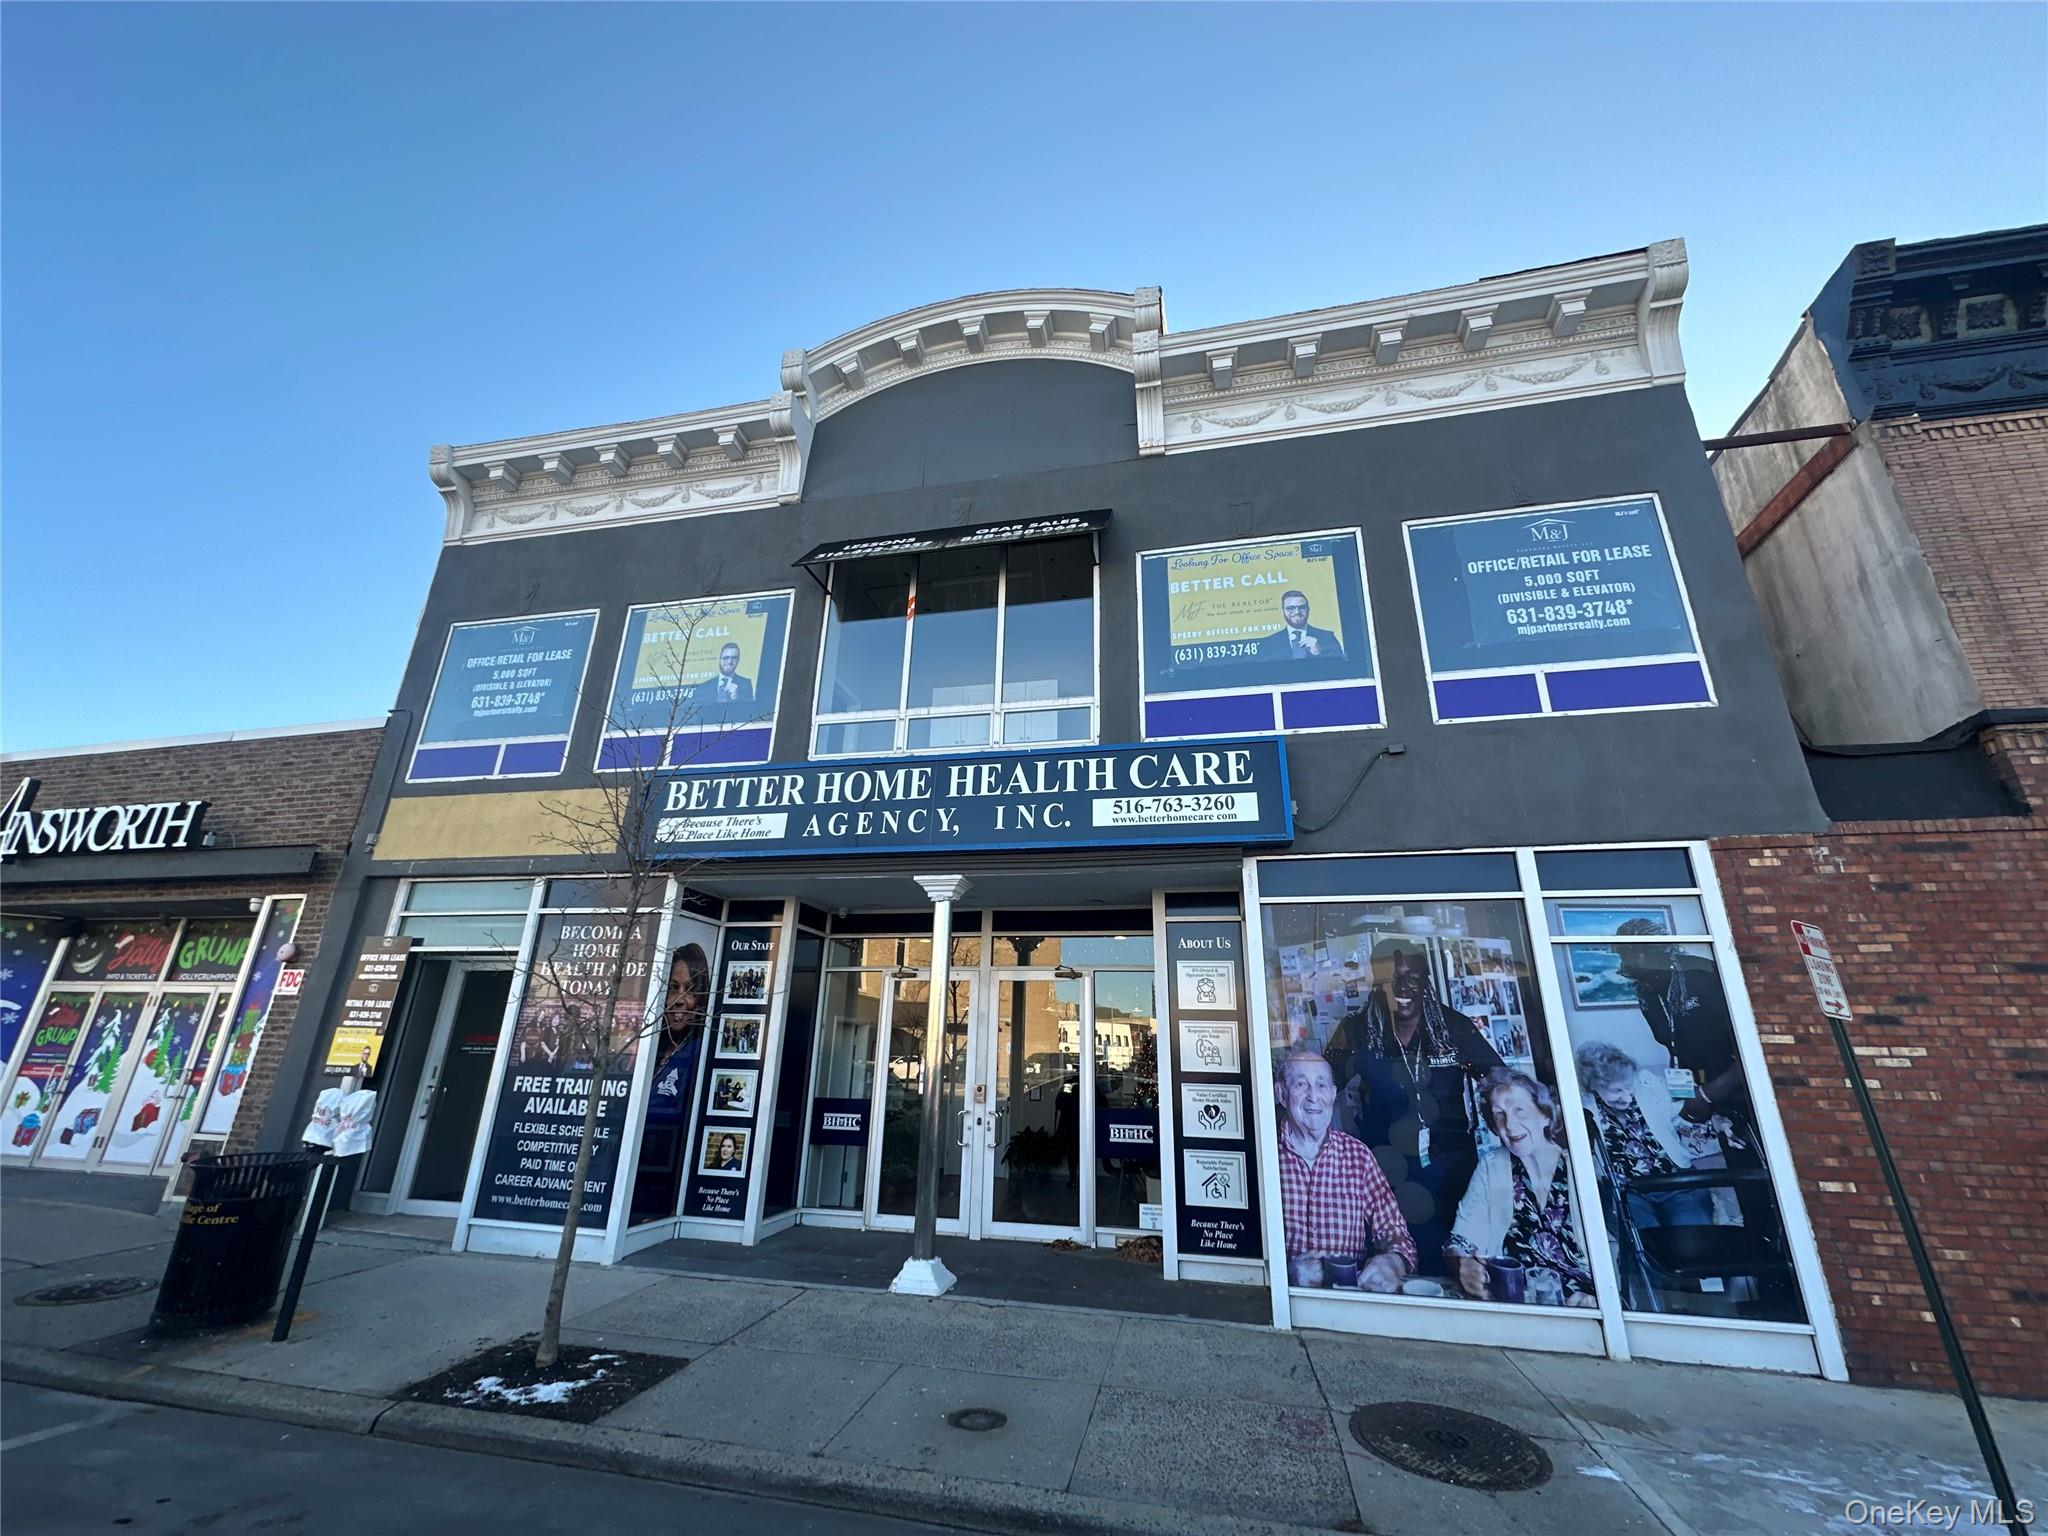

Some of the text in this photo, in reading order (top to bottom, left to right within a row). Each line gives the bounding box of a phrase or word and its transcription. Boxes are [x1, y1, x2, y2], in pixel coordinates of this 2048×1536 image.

[976, 518, 1080, 534] GEAR SALES
[1531, 524, 1568, 541] M&J
[843, 537, 916, 550] LESSONS
[1170, 558, 1209, 571] Looking
[1211, 554, 1228, 566] For
[1231, 551, 1261, 564] Office
[1264, 546, 1300, 560] Space?
[1468, 544, 1652, 574] OFFICE/RETAIL FOR LEASE
[1170, 571, 1288, 594] BETTER CALL
[1524, 569, 1599, 587] 5,000 SQFT
[1498, 582, 1636, 604] (DIVISIBLE & ELEVATOR)
[696, 625, 731, 639] CALL
[1171, 630, 1202, 640] SPEEDY
[1206, 627, 1239, 636] OFFICES
[1243, 625, 1259, 633] FOR
[1517, 617, 1631, 635] mjpartnersrealty.com
[527, 652, 544, 663] FOR
[545, 648, 574, 661] LEASE
[1174, 647, 1203, 665] (631)
[517, 667, 538, 678] SQFT
[631, 691, 654, 706] (631)
[663, 750, 1254, 812] BETTER HOME HEALTH CARE
[1112, 794, 1236, 815] 516-763-3260
[682, 815, 763, 829] Because There's
[802, 802, 1072, 838] AGENCY, INC.
[687, 830, 714, 840] Place
[715, 829, 739, 839] Like
[740, 828, 771, 838] Home
[630, 926, 641, 939] A
[572, 943, 621, 958] HOME
[607, 962, 647, 977] ADE
[280, 971, 304, 988] FDC
[560, 980, 611, 995] TODAY
[35, 1027, 79, 1047] GRUMP
[513, 1076, 628, 1098] FREE TRAIING
[524, 1097, 608, 1118] AVAILABE
[513, 1122, 557, 1136] FLEXIBLE
[516, 1140, 579, 1155] COMPETITIVE
[520, 1158, 542, 1170] PAID
[543, 1159, 566, 1172] TIME
[495, 1173, 533, 1188] CAREER
[720, 1187, 740, 1197] There's
[197, 1215, 239, 1225] Centre
[1190, 1218, 1245, 1231] Because There's
[1202, 1229, 1234, 1240] No Place
[1200, 1239, 1237, 1250] Like Home
